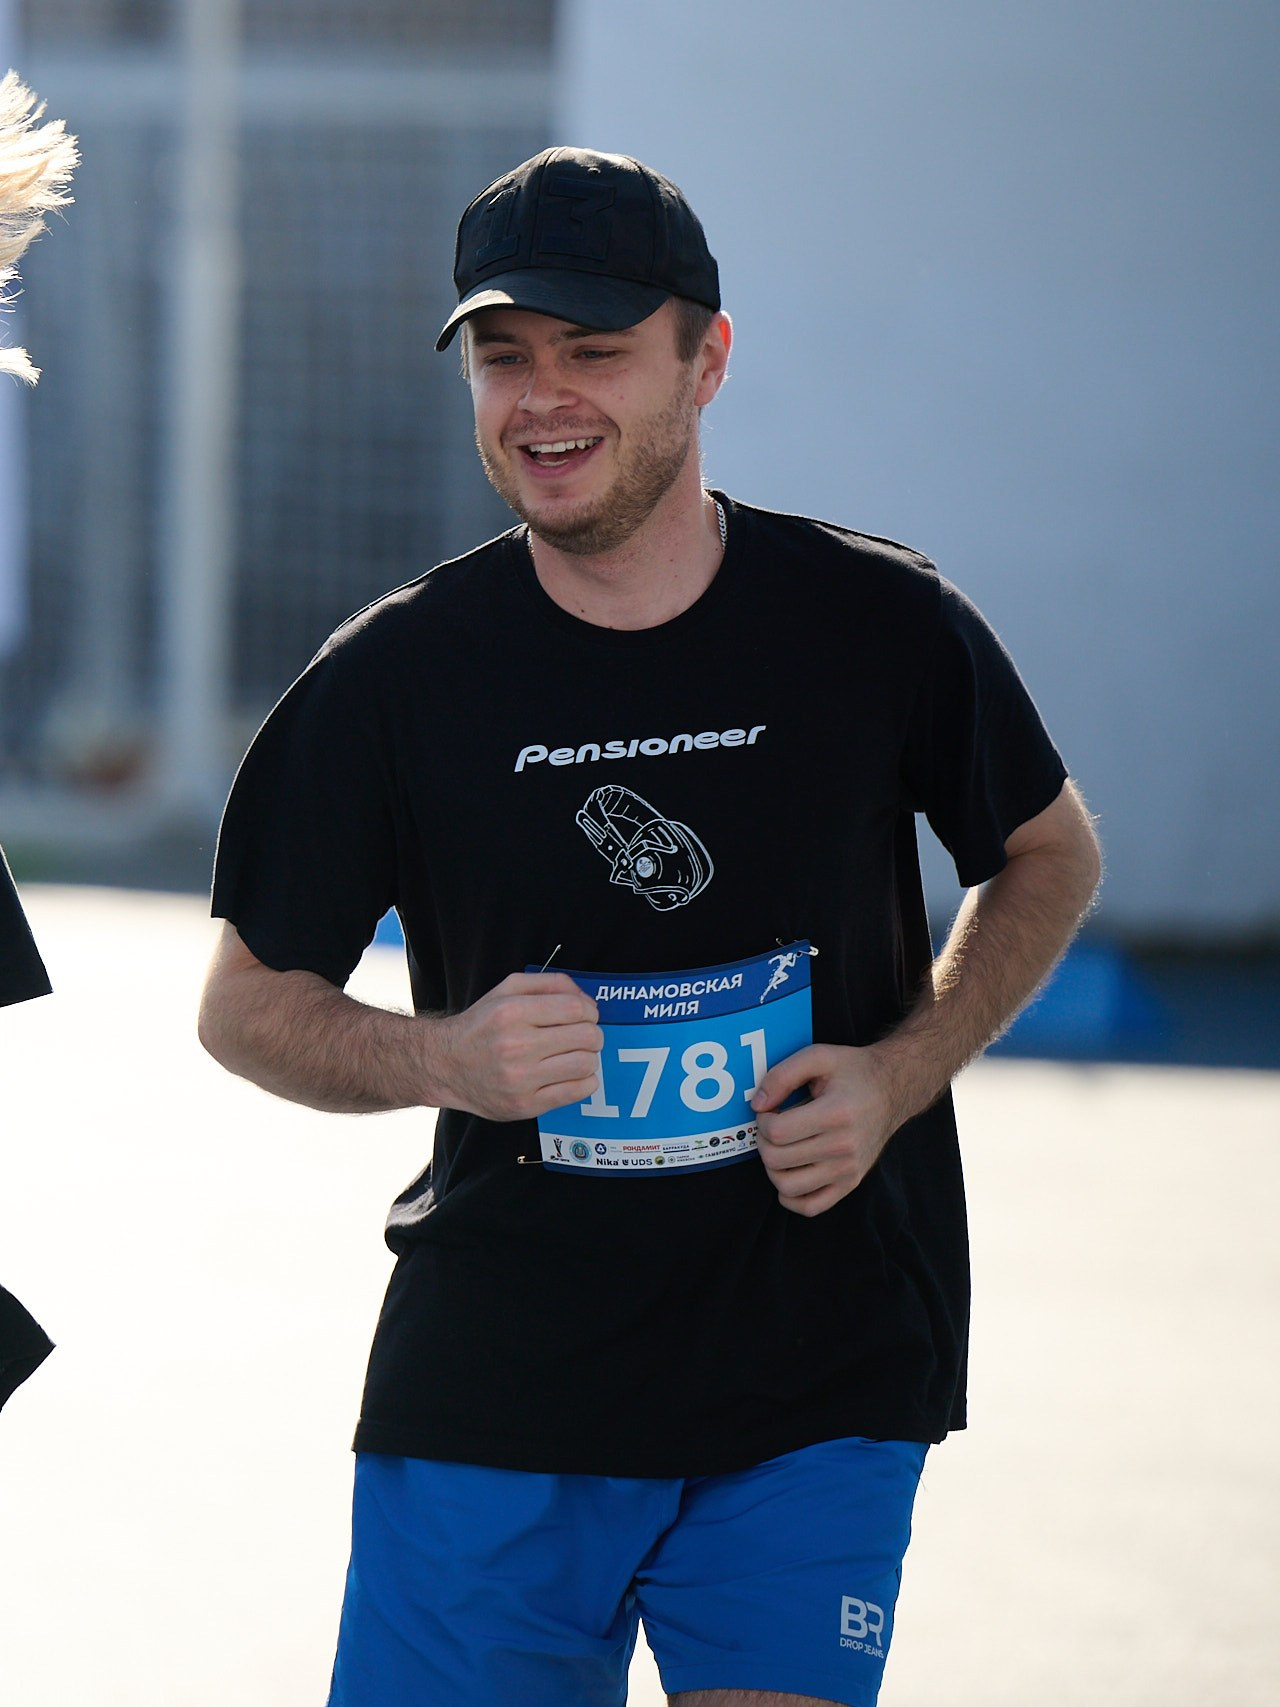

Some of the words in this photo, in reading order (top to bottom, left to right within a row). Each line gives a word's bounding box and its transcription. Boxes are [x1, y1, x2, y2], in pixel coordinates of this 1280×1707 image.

[595, 973, 744, 1002] ДИНАМОВСКАЯ
[643, 1000, 700, 1019] МИЛЯ
[580, 1028, 768, 1118] 1781
[622, 1144, 661, 1153] РОНДАМИТ
[596, 1158, 619, 1166] Nika
[631, 1158, 653, 1166] UDS
[840, 1595, 884, 1647] BR
[839, 1637, 864, 1651] DROP
